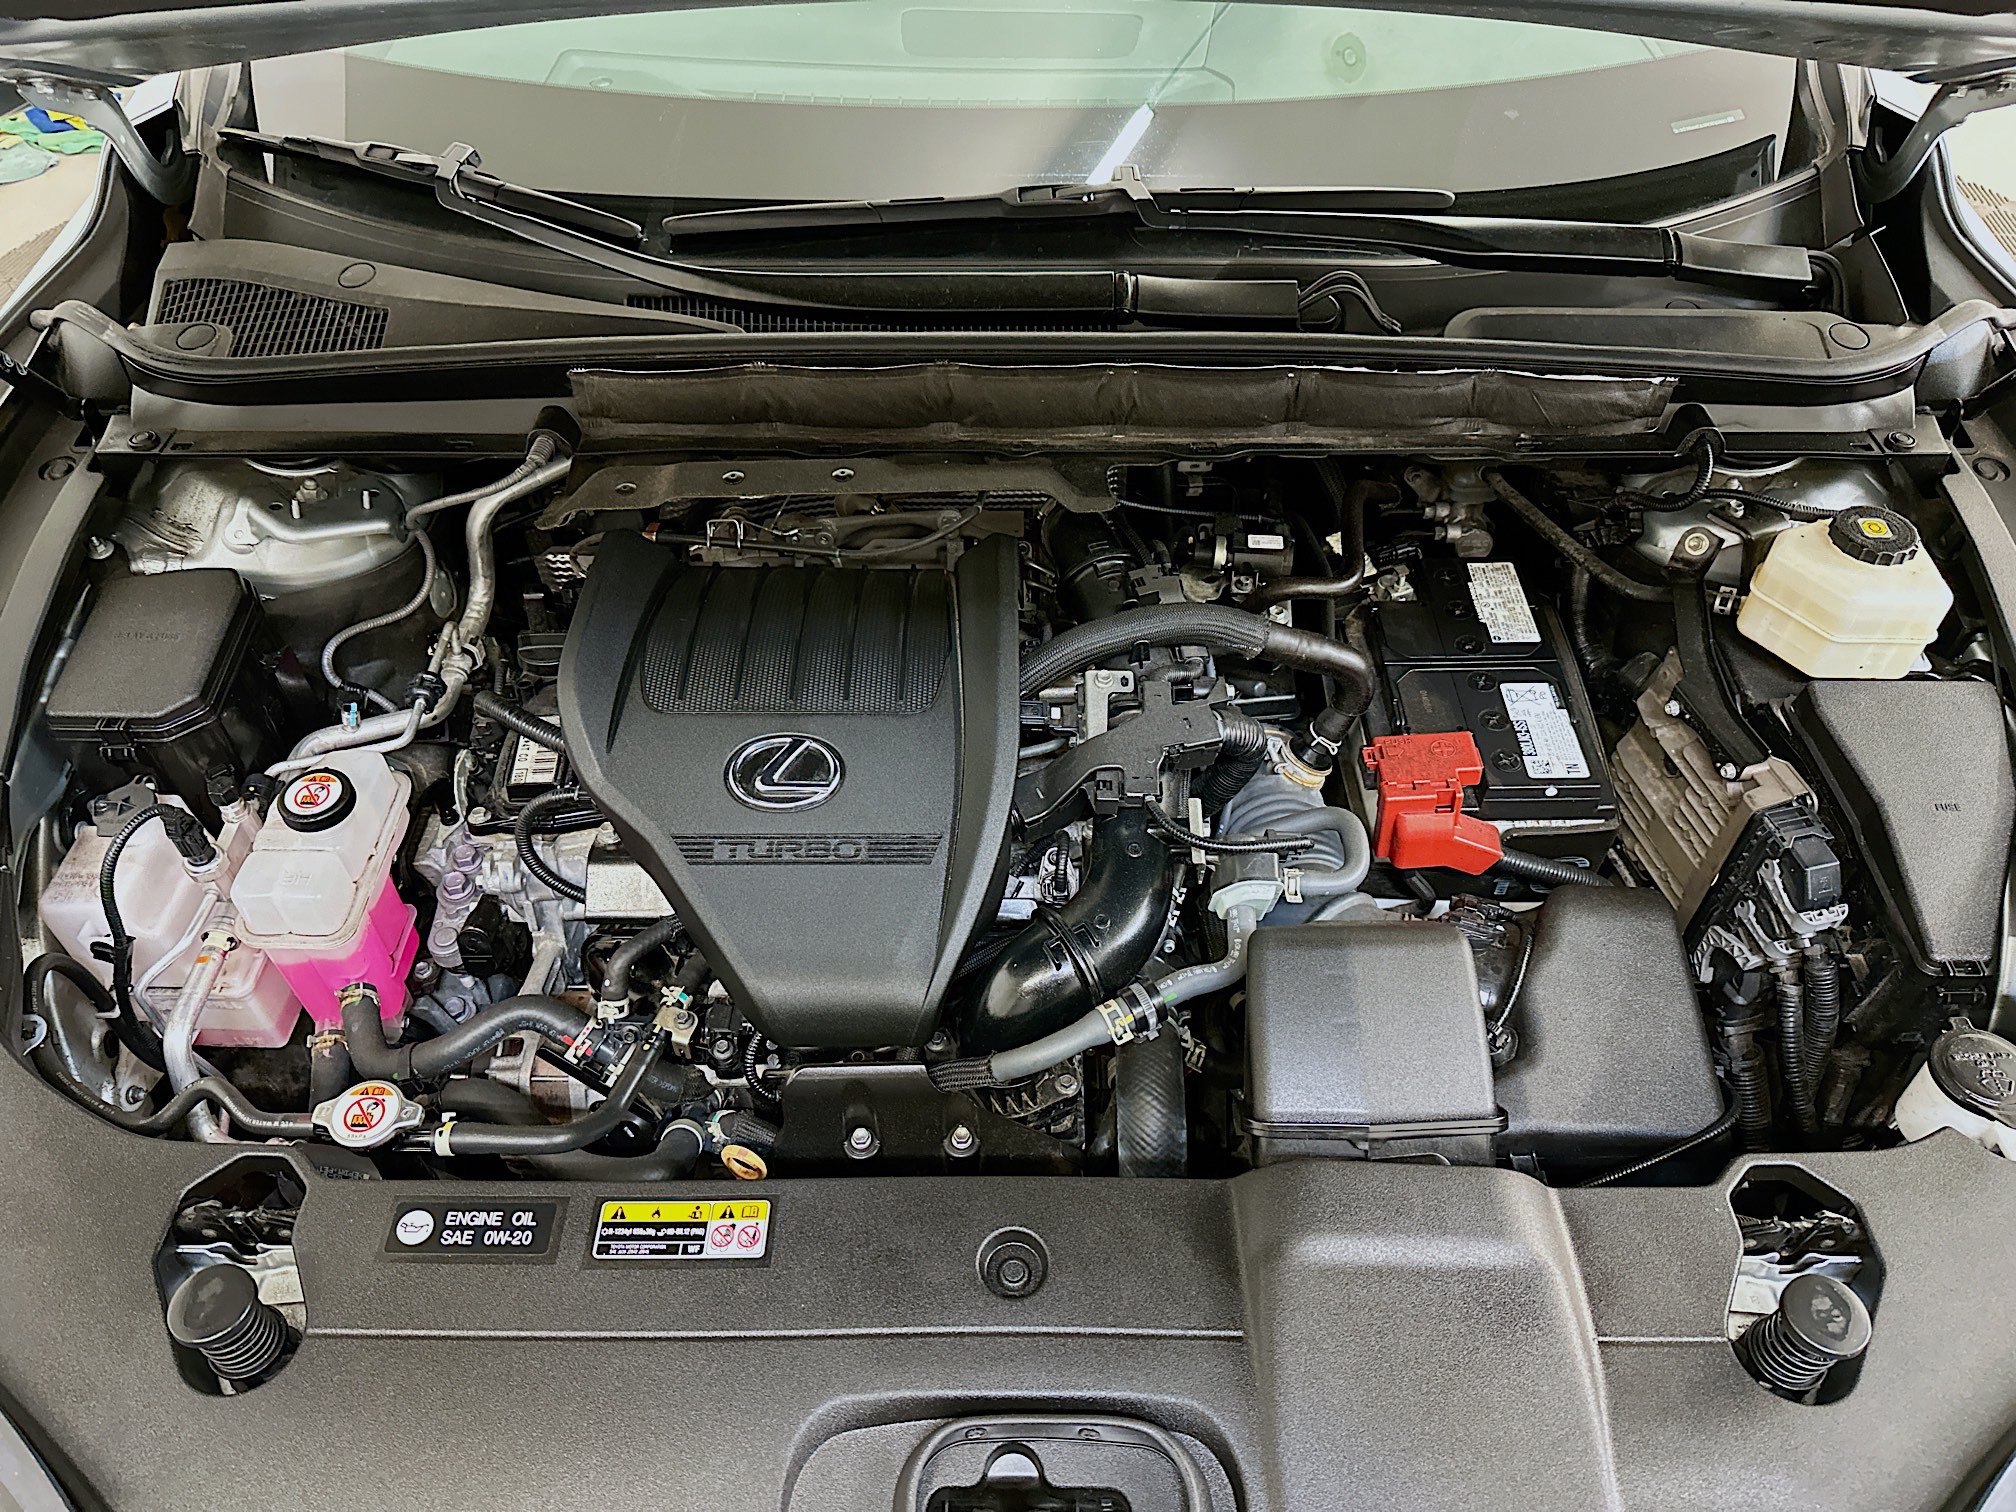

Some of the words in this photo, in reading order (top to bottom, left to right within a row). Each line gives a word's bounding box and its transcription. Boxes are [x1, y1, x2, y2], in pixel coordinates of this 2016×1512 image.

[1934, 803, 1961, 811] FUSE
[718, 840, 864, 859] TURBO
[445, 1211, 504, 1226] ENGINE
[511, 1211, 537, 1226] OIL
[440, 1230, 474, 1245] SAE
[483, 1230, 533, 1246] 0W-20
